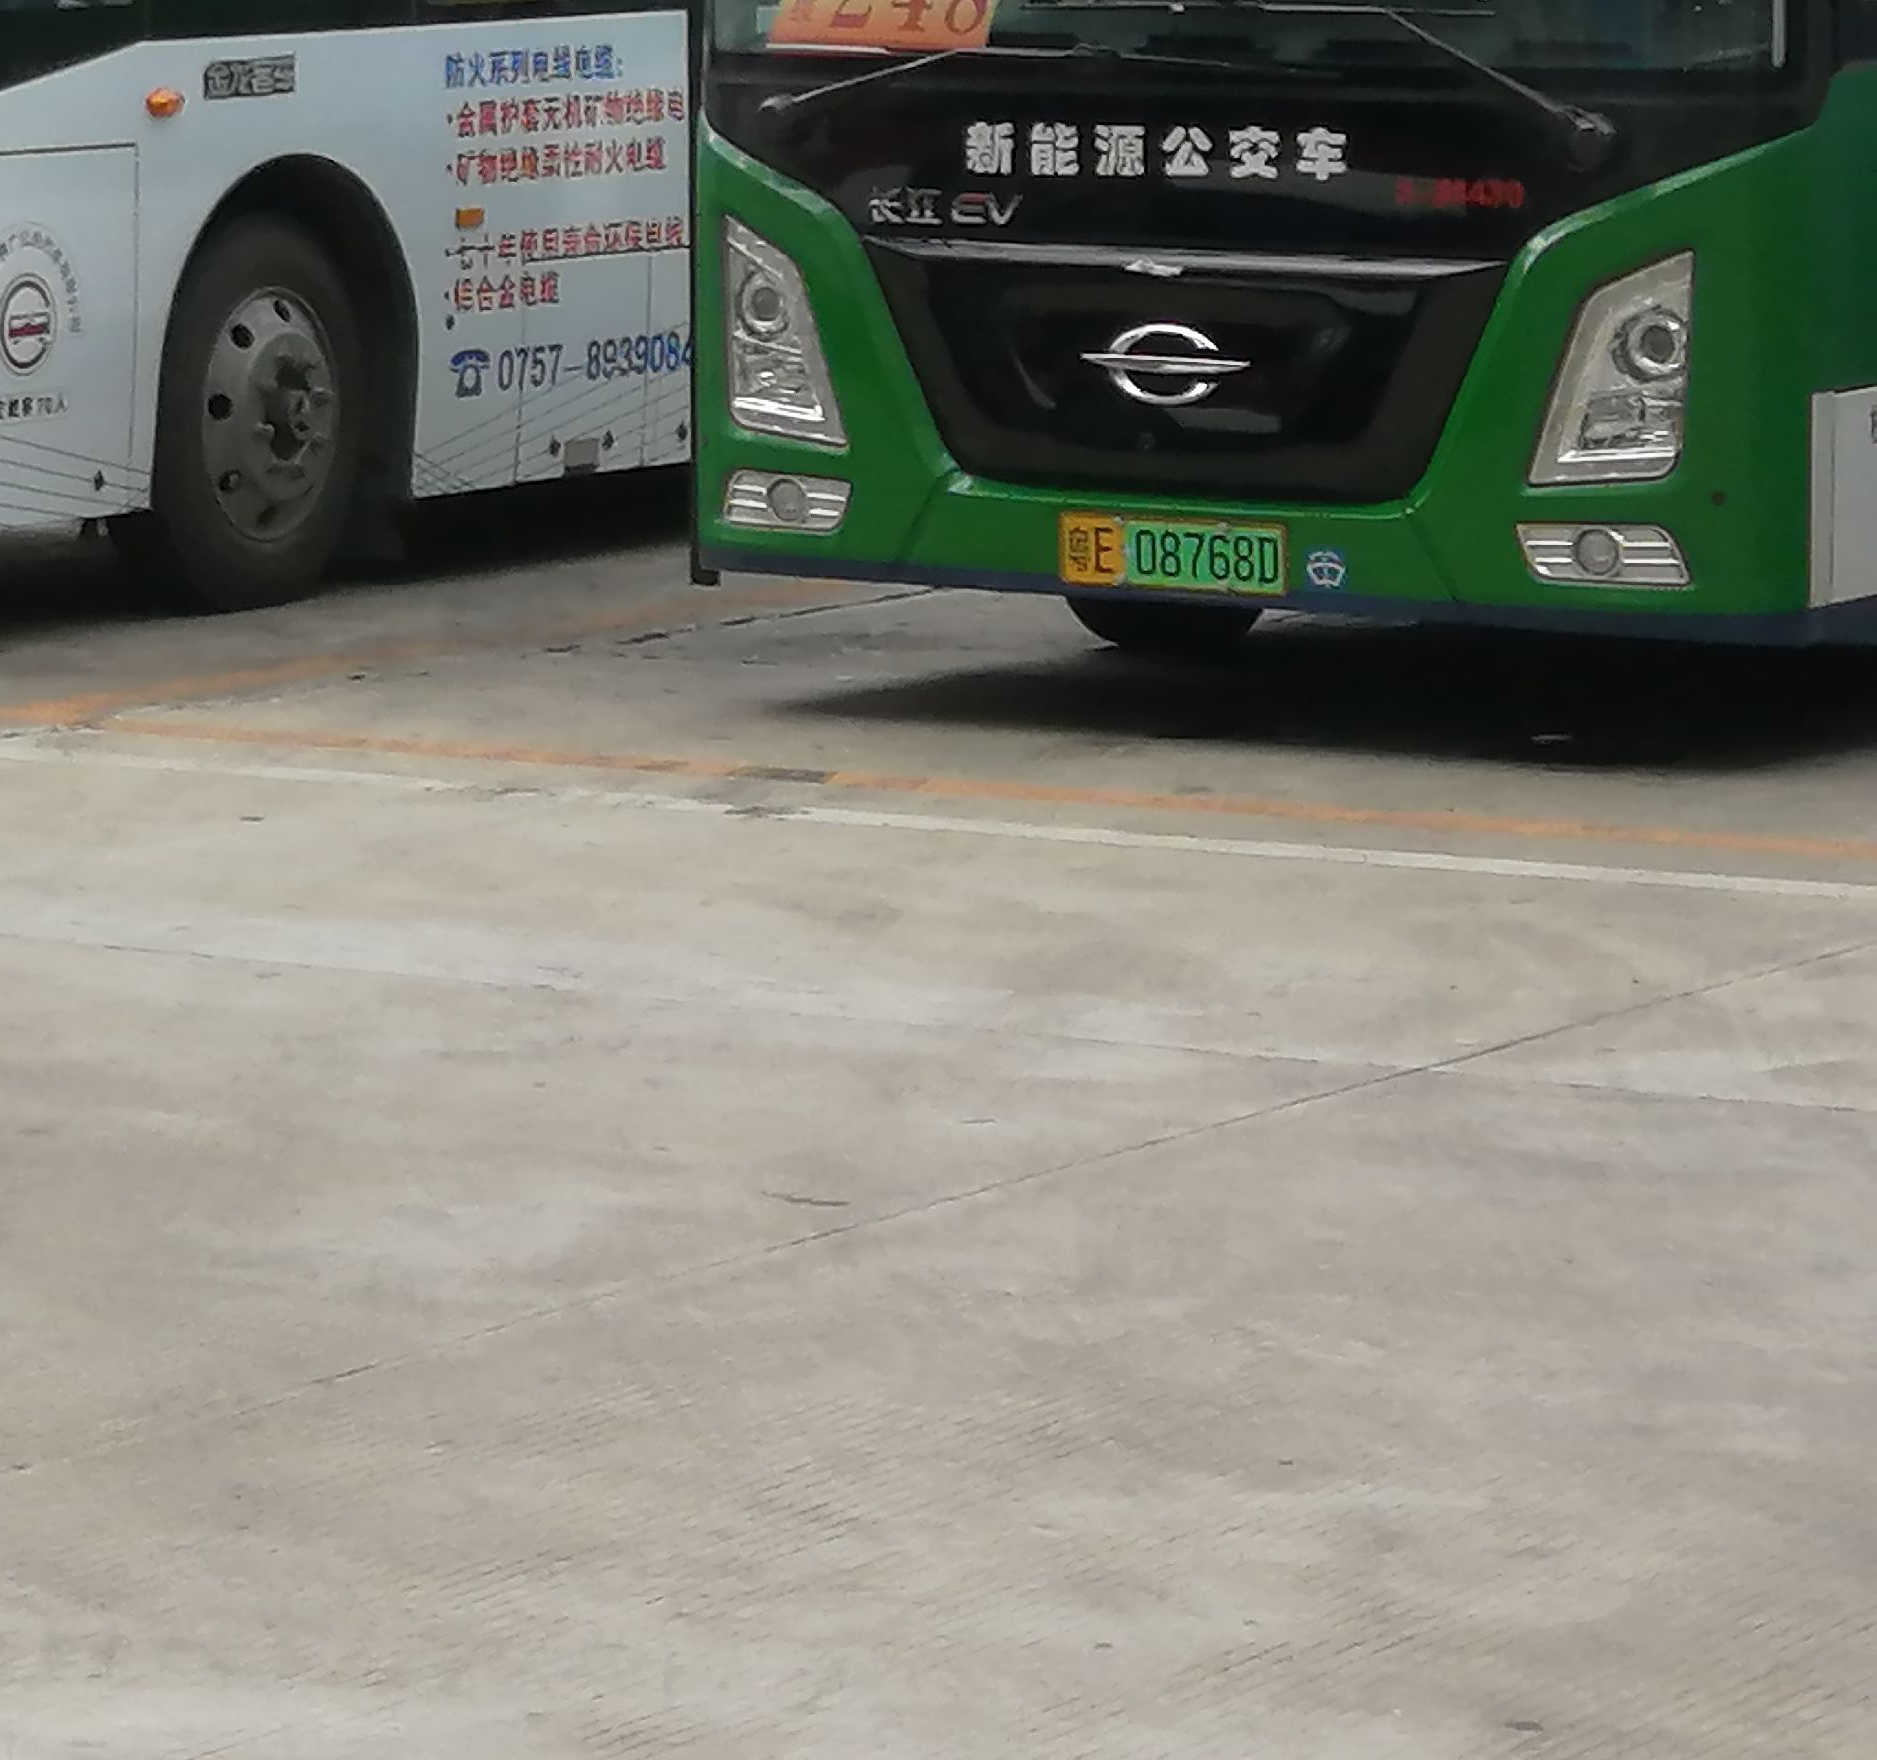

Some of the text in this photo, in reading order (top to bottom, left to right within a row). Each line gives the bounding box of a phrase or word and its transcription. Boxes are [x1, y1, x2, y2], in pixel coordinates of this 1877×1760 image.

[965, 122, 1346, 181] 新能源公交车
[950, 192, 1024, 226] EV
[1134, 529, 1280, 584] 08768D
